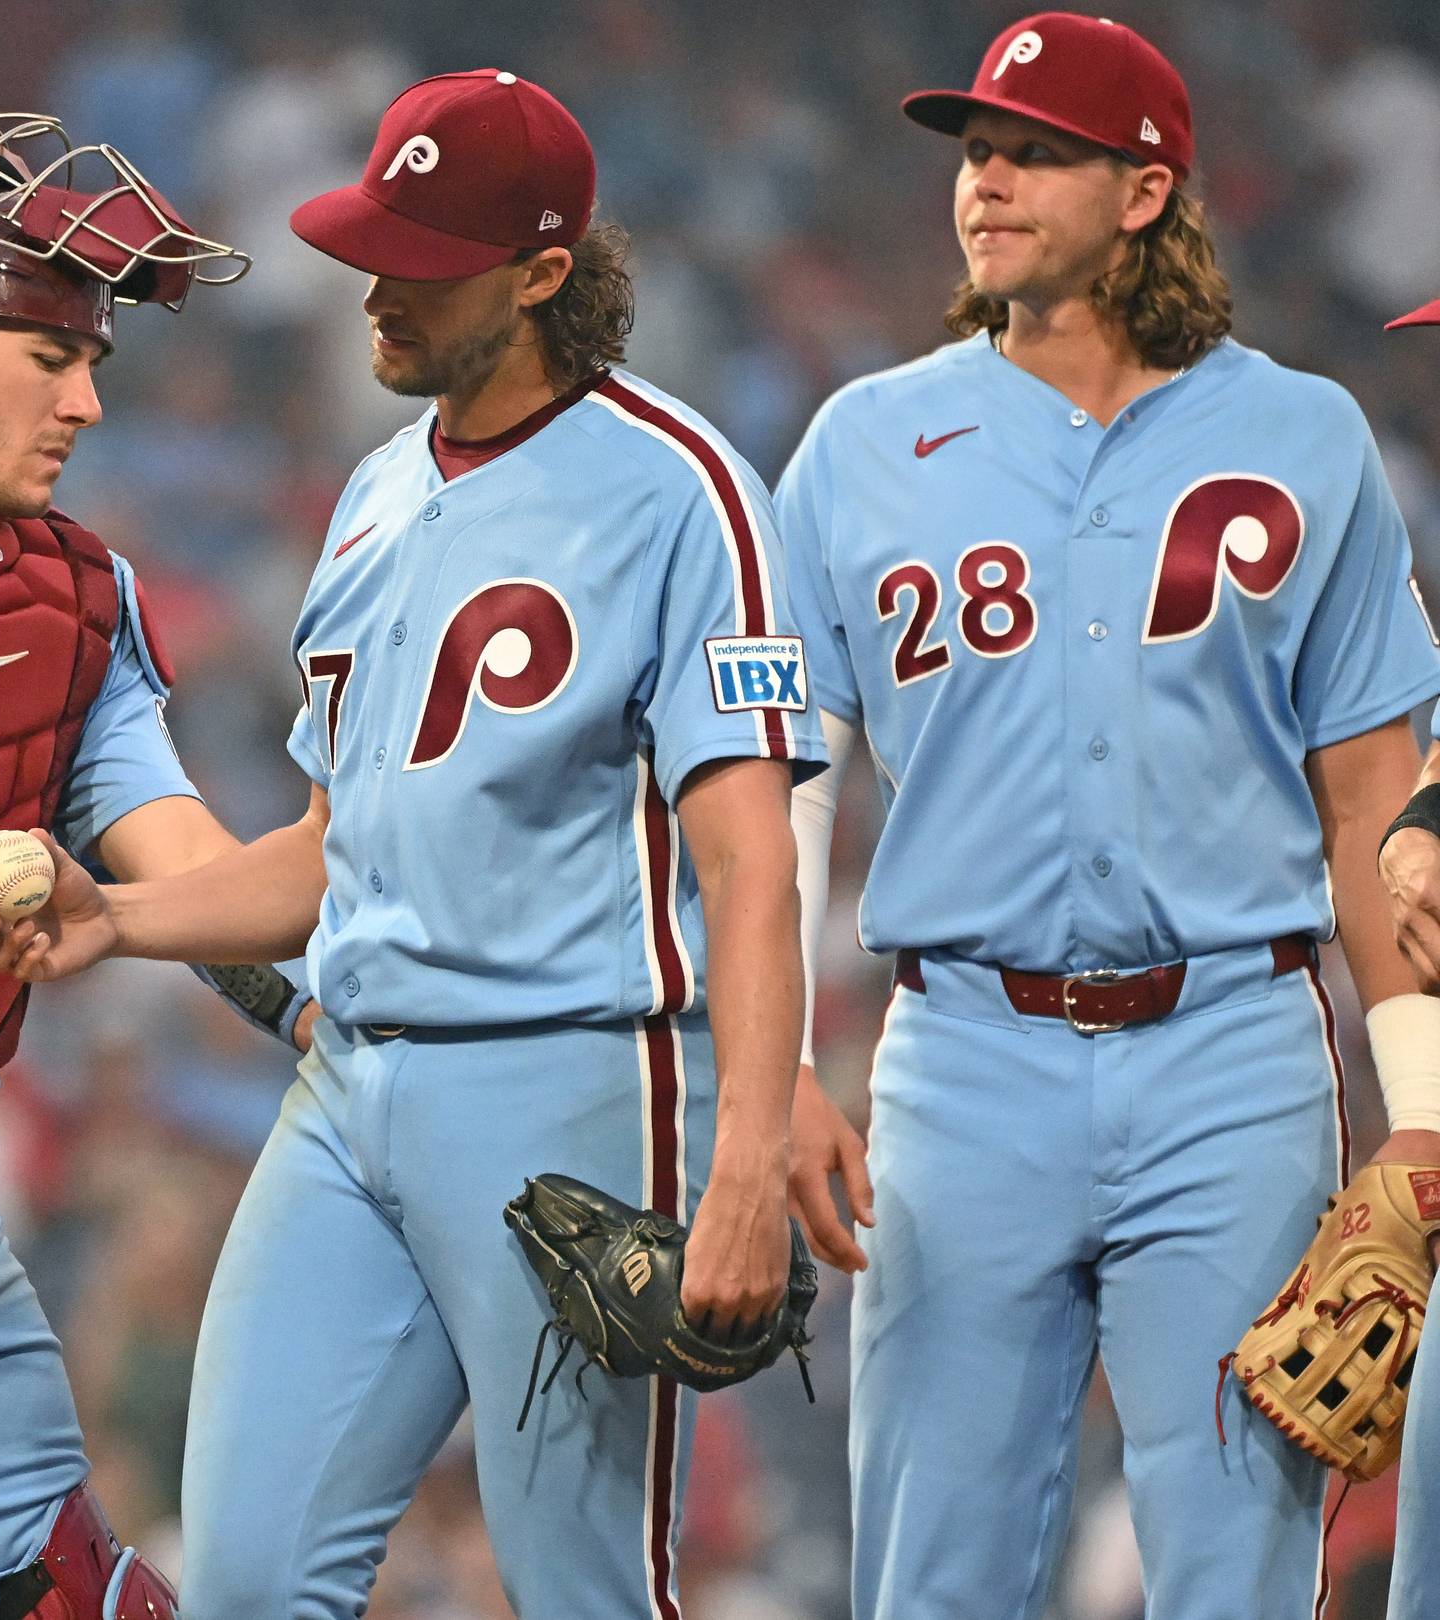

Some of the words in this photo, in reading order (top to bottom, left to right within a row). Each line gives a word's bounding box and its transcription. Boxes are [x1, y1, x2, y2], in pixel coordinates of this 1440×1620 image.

[992, 30, 1043, 80] P
[382, 134, 440, 181] P
[1141, 472, 1305, 645] P
[875, 540, 1038, 689] 28
[402, 577, 580, 771] P
[714, 643, 787, 656] Independence
[717, 660, 804, 705] IBX
[300, 648, 355, 776] 7
[1340, 1203, 1371, 1239] 28
